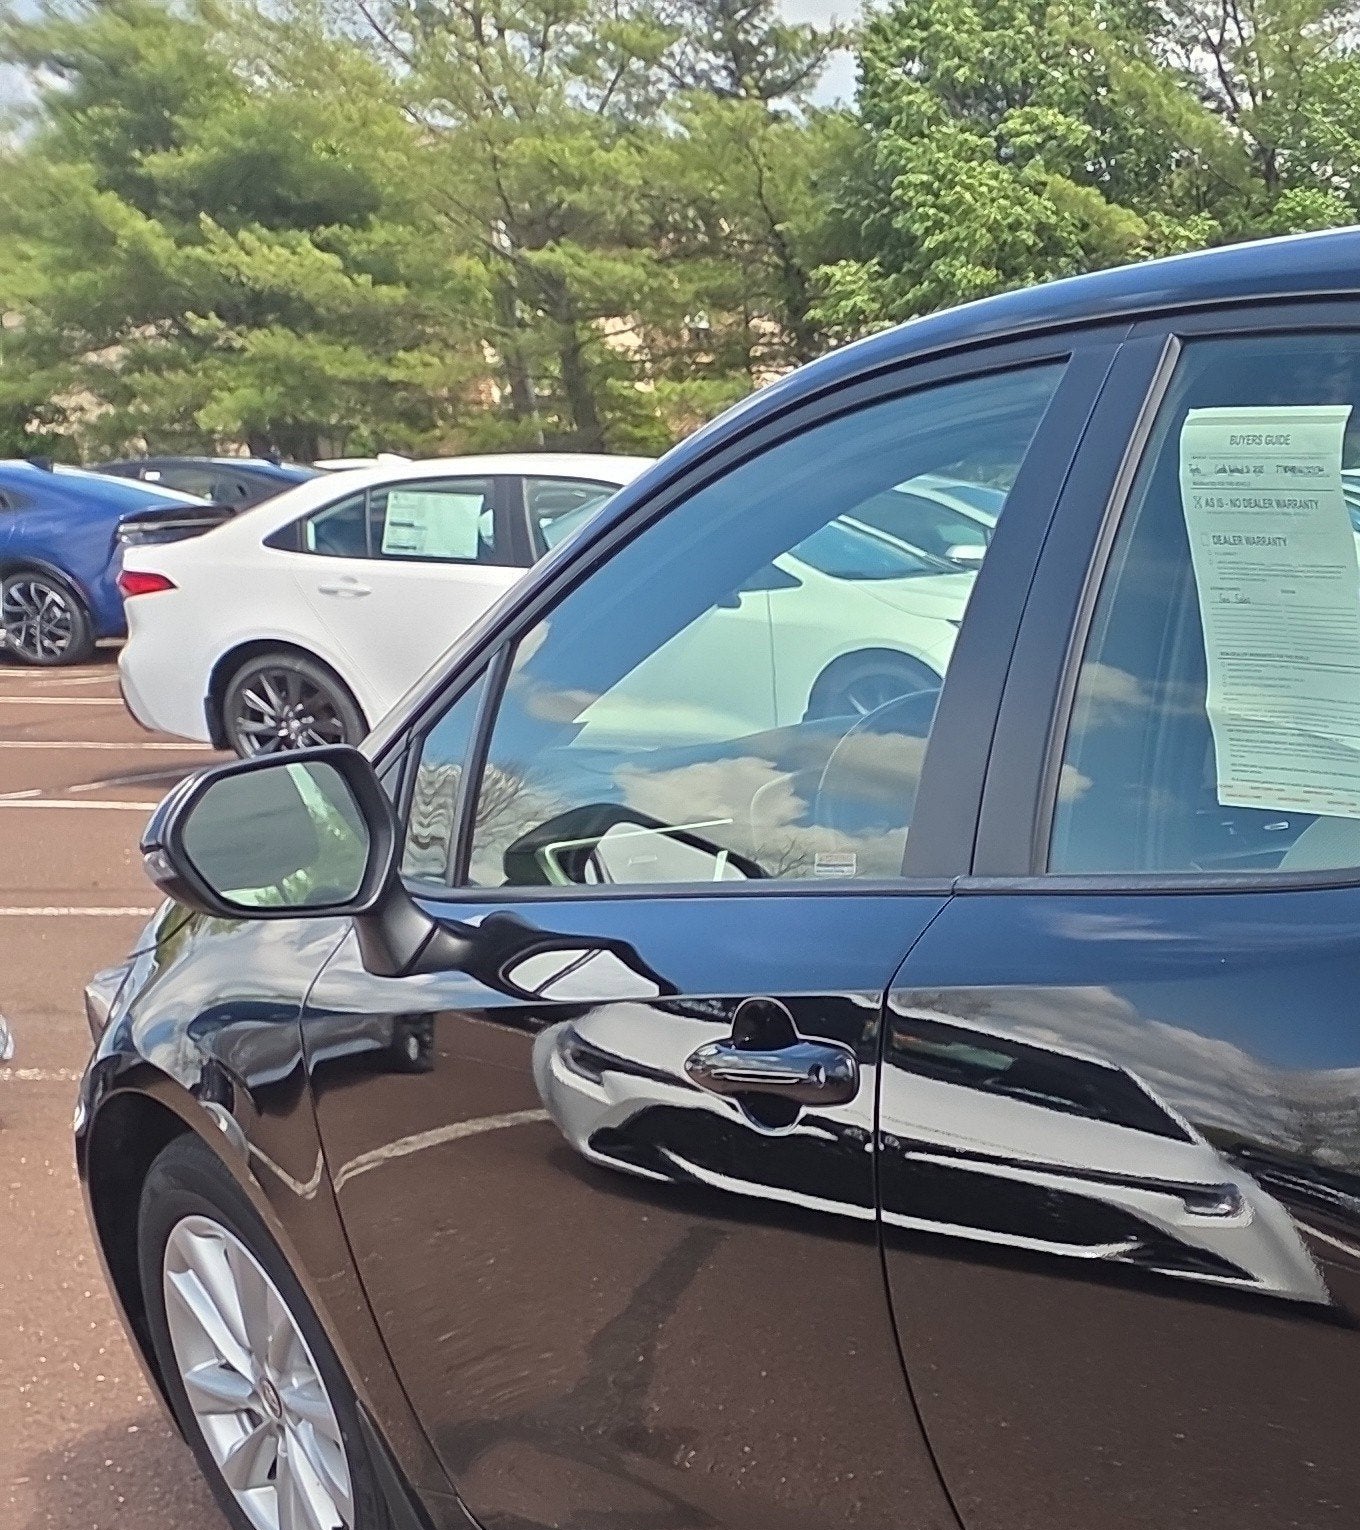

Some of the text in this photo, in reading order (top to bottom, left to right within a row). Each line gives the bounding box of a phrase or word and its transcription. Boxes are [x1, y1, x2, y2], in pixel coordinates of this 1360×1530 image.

[1229, 434, 1292, 446] BUYERS GUIDE
[1205, 497, 1214, 508] AS
[1230, 498, 1241, 509] NO
[1243, 498, 1274, 509] DEALER
[1275, 498, 1319, 510] WARRANTY
[1212, 534, 1287, 547] DEALER WARRANTY
